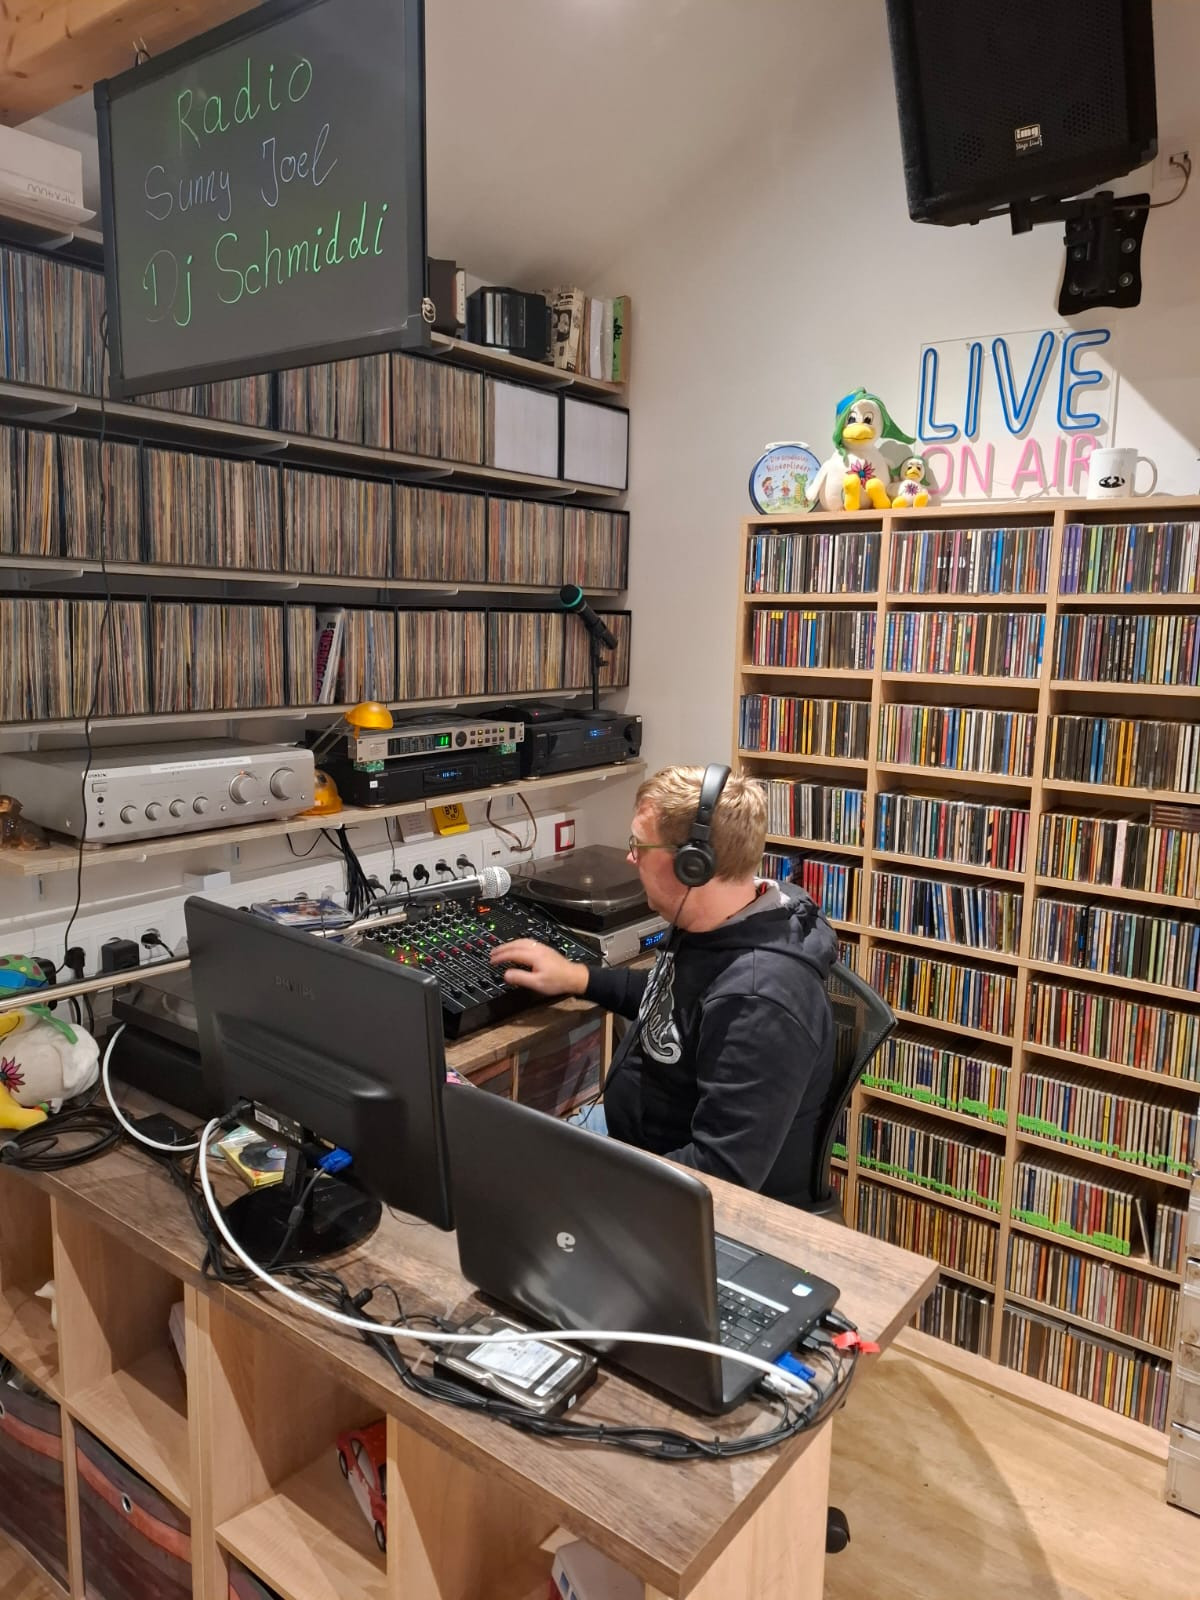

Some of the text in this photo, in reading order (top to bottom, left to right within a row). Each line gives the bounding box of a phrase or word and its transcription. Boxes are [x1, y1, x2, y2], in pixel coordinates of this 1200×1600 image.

[177, 58, 313, 151] Radio
[144, 123, 338, 221] Sunny Joel
[215, 201, 389, 304] Schmiddi
[918, 328, 1111, 442] LIVE
[920, 432, 1097, 495] ON AIR
